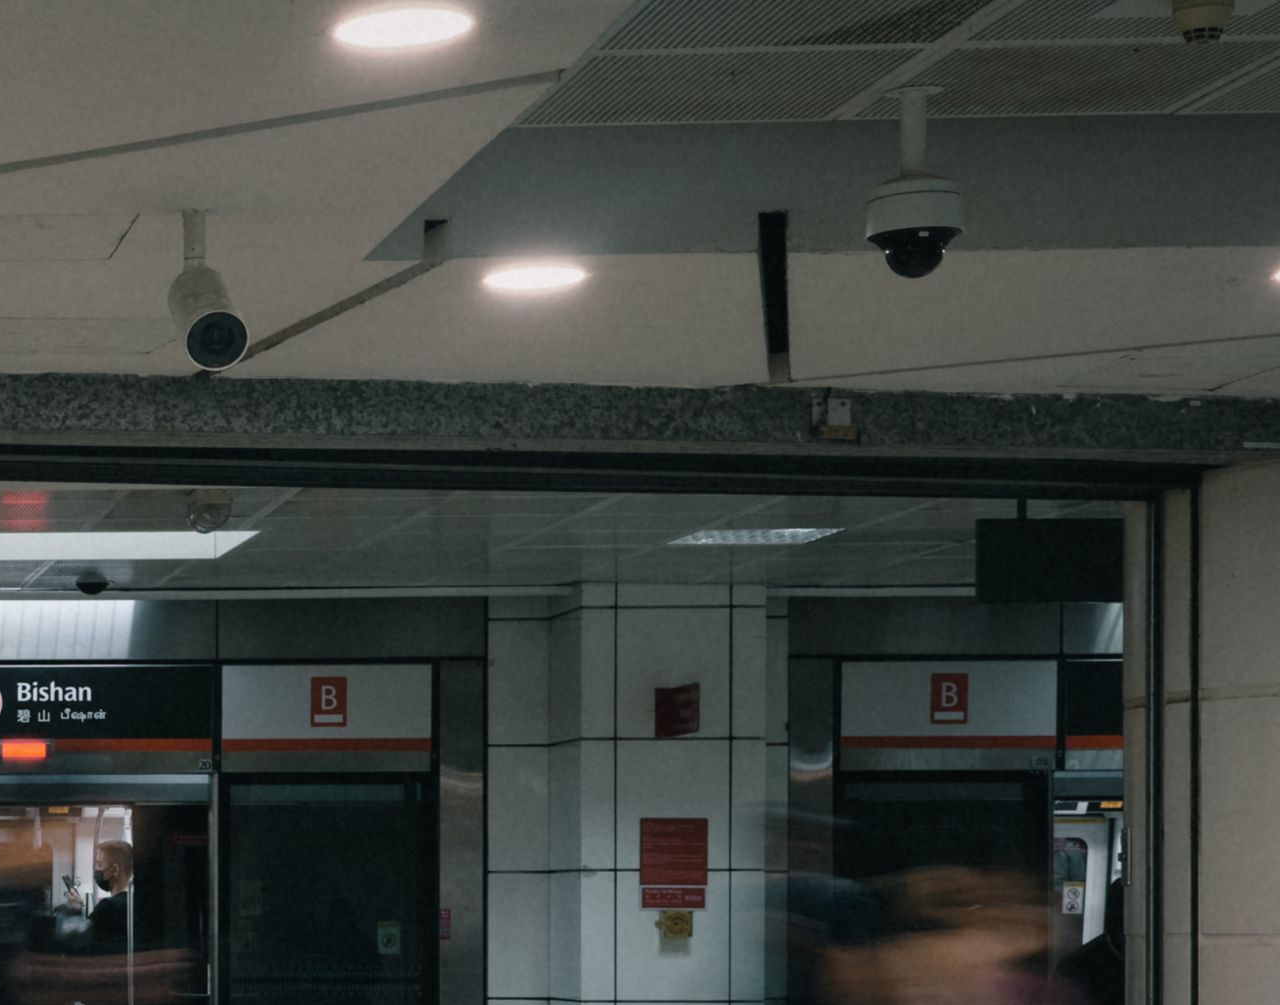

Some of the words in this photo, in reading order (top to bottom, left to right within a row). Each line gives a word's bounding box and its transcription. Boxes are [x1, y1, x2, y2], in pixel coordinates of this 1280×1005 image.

[16, 681, 92, 702] Bishan
[320, 685, 338, 710] B
[941, 682, 958, 707] B
[199, 760, 211, 770] 20
